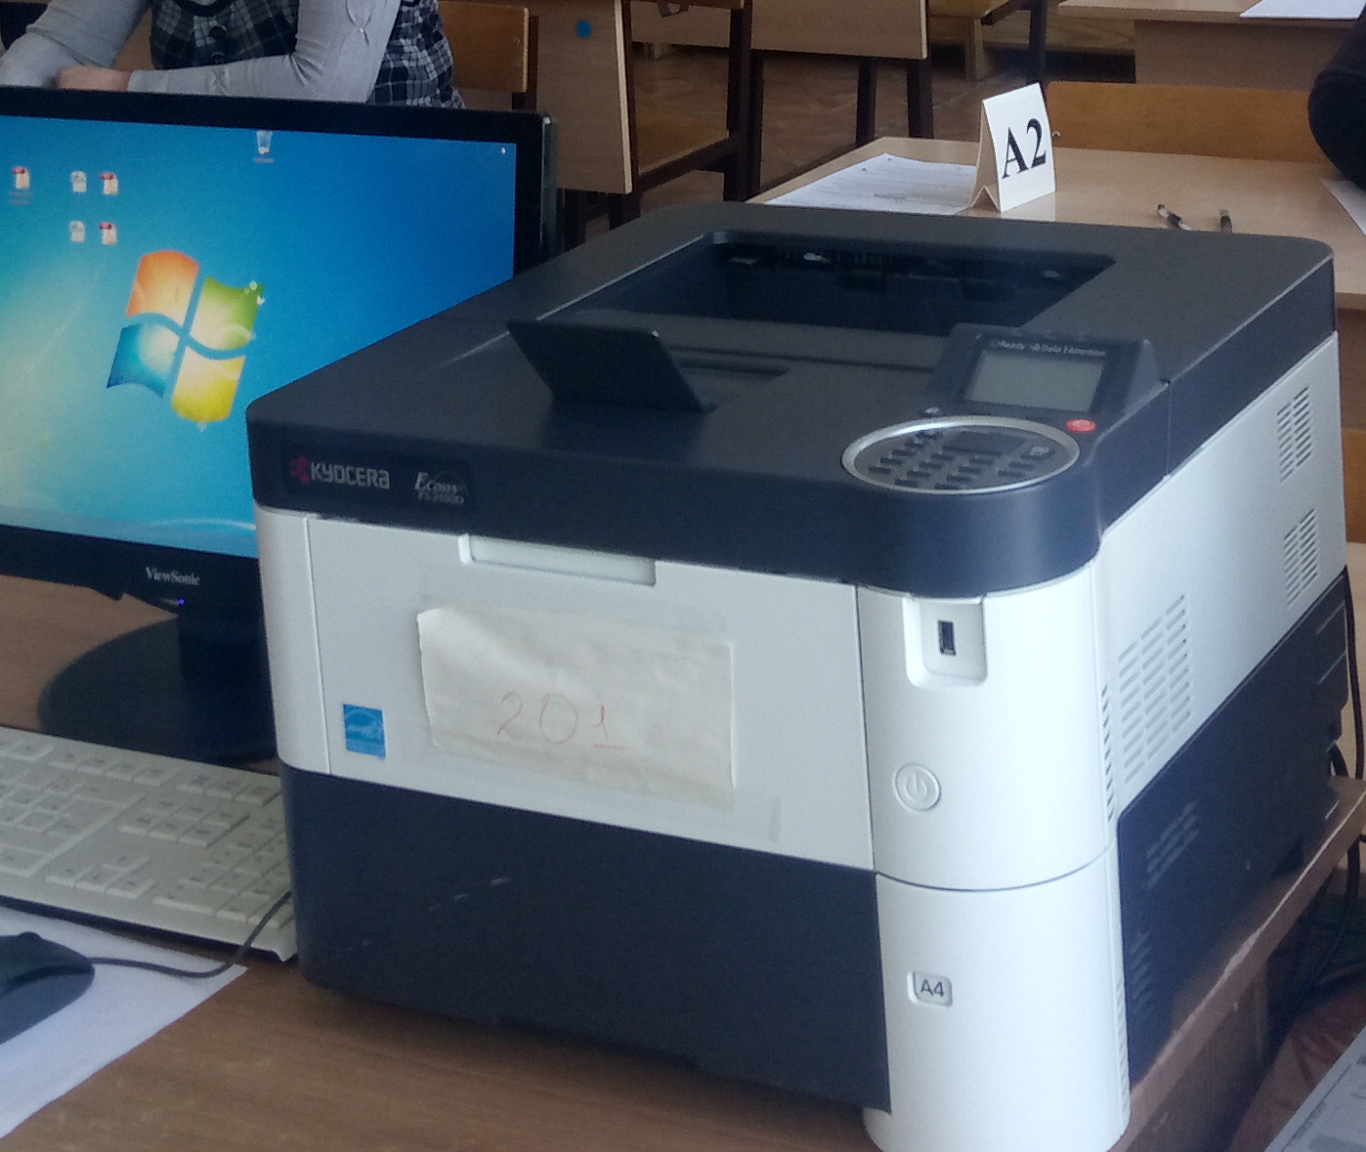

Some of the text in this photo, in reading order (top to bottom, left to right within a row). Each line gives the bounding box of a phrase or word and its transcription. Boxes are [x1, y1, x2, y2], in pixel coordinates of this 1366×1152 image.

[1002, 118, 1047, 179] А2
[310, 461, 391, 490] KYOCERA
[145, 566, 201, 586] ViewSonic
[497, 691, 631, 750] 201
[920, 978, 945, 998] A4
